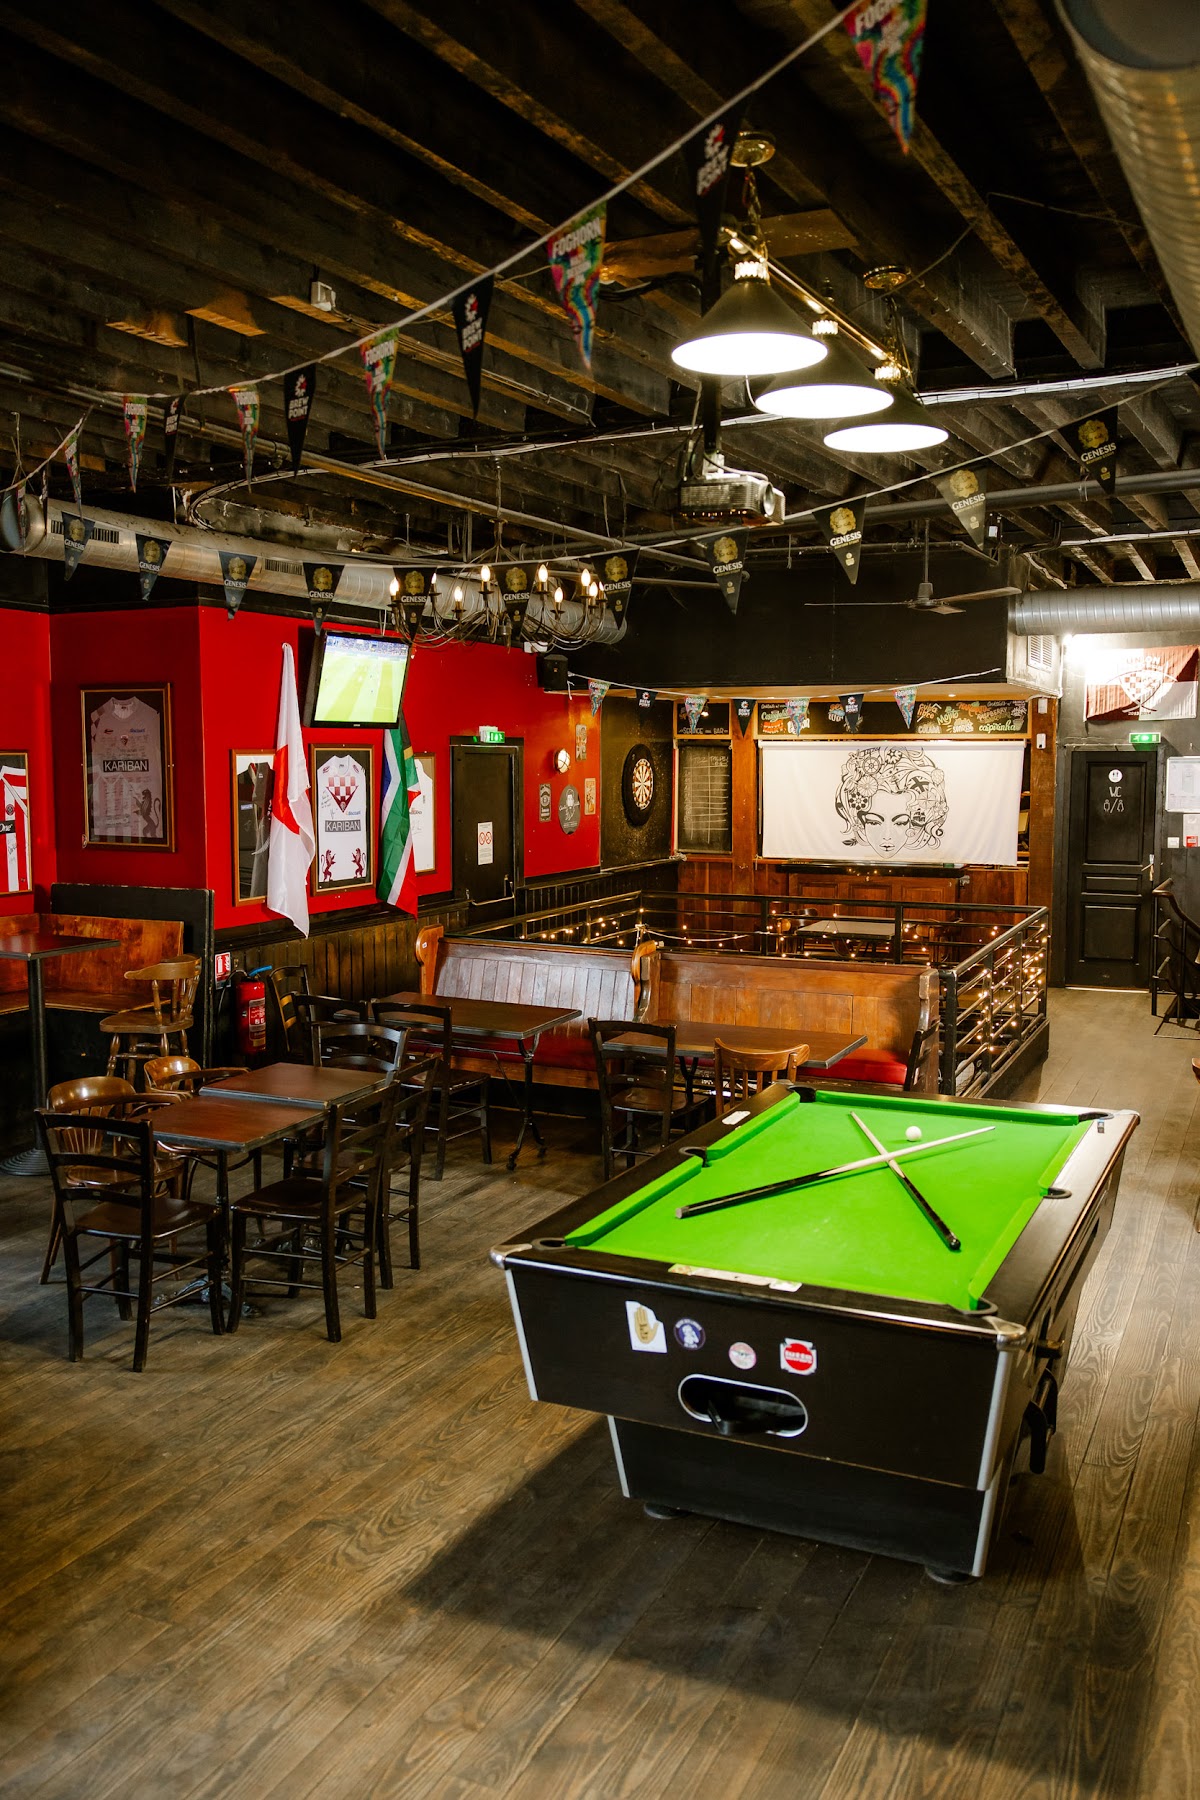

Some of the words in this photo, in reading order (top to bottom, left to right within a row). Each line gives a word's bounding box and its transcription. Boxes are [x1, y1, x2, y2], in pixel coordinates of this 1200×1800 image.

[552, 217, 602, 259] FOGHORN
[289, 396, 309, 410] BREW
[288, 405, 308, 419] POINT
[1080, 442, 1117, 462] GENESIS
[951, 493, 986, 511] GENESIS
[64, 539, 85, 551] GENESIS
[829, 531, 862, 547] GENESIS
[139, 561, 160, 572] GENESIS
[712, 560, 743, 574] GENESIS
[224, 579, 247, 589] GENESIS
[603, 580, 632, 592] GENESIS
[309, 590, 334, 599] GENESIS
[401, 595, 428, 603] GENESIS
[503, 592, 530, 601] GENESIS
[1127, 656, 1160, 666] UNION
[104, 760, 147, 771] KARIBAN
[1109, 786, 1121, 797] WC
[326, 820, 360, 832] KARIBAN
